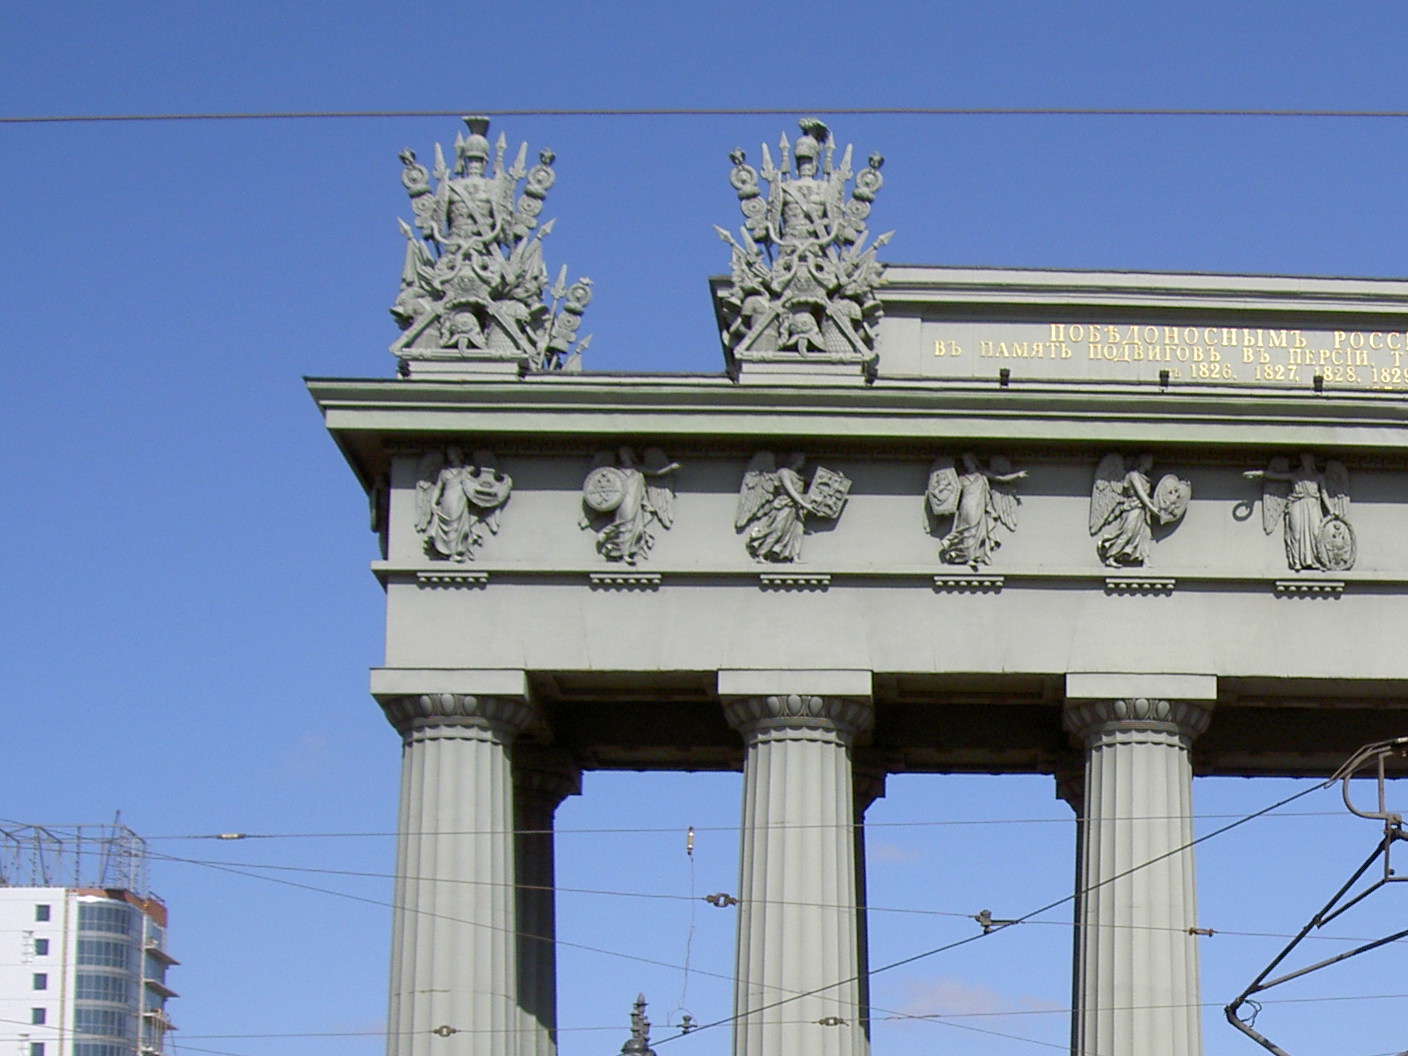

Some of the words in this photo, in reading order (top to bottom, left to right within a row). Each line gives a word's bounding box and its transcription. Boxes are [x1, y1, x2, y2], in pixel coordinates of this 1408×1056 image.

[933, 340, 962, 357] ВЪ
[979, 340, 1073, 360] ПАМЯТЬ
[1088, 343, 1222, 363] ПОДВИГОВЪ
[1242, 346, 1271, 364] ВЪ
